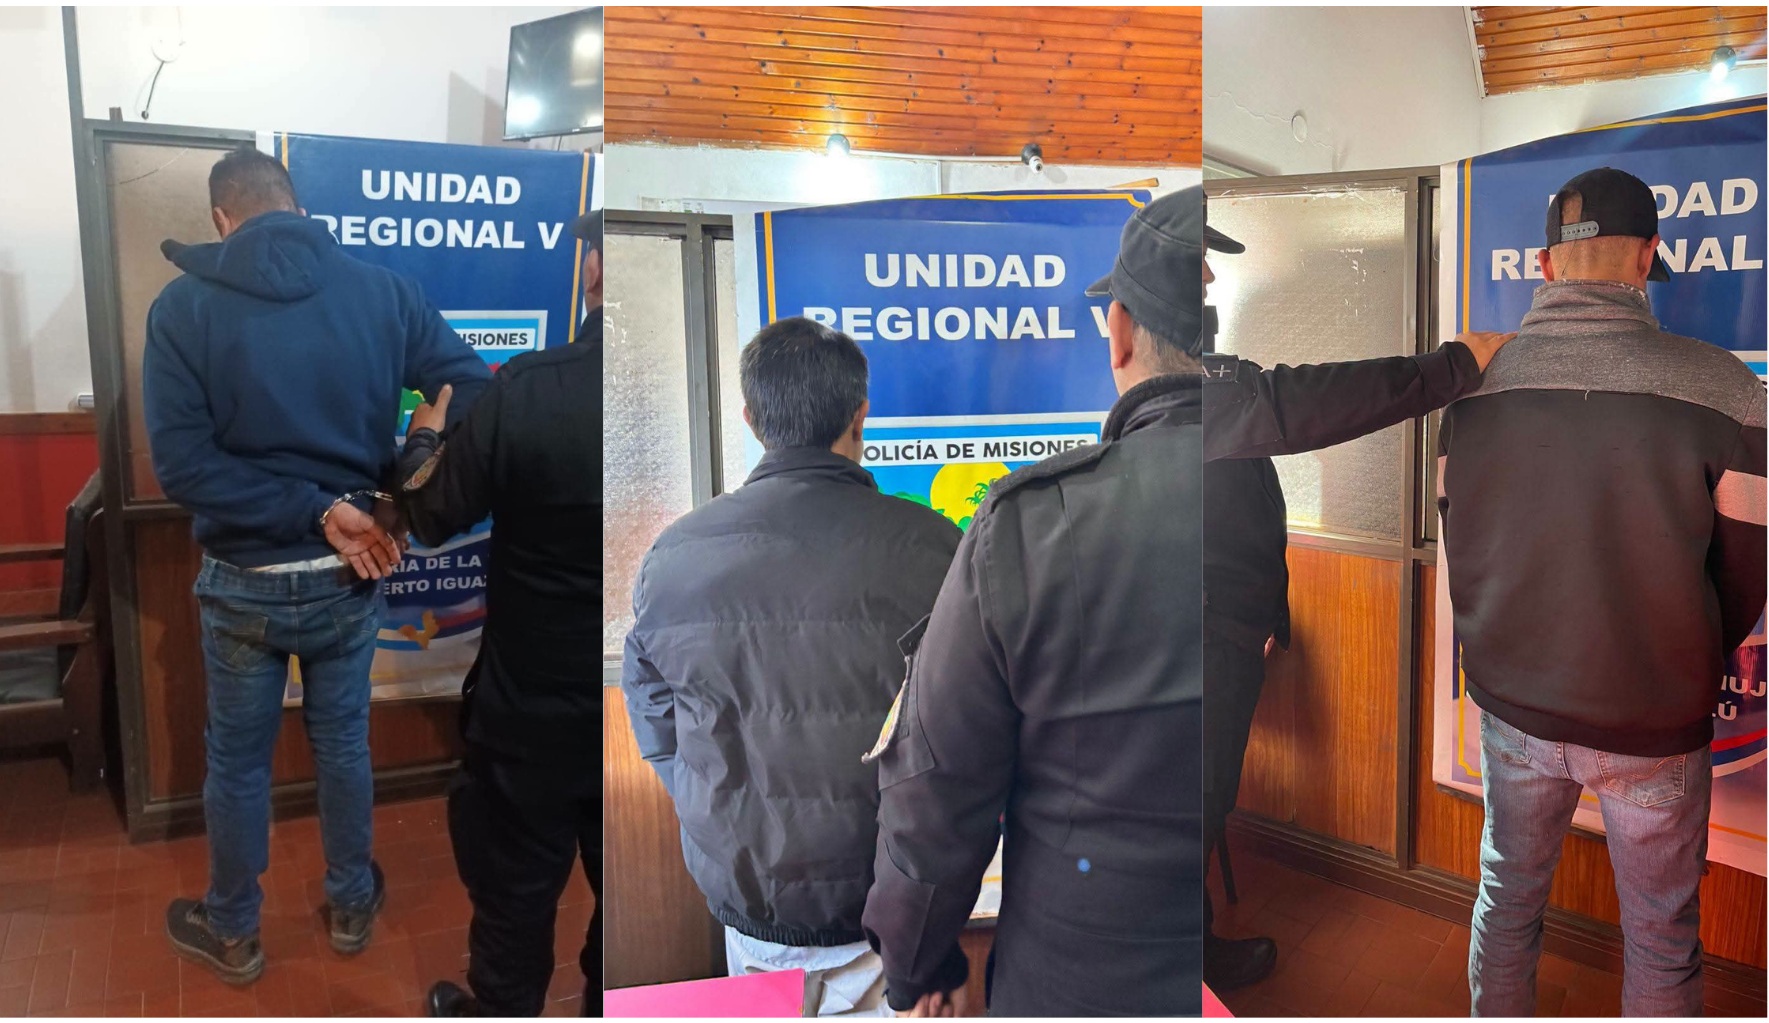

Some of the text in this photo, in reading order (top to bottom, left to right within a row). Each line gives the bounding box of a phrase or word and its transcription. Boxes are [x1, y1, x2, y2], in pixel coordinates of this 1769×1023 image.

[361, 169, 521, 205] UNIDAD
[538, 222, 564, 250] V
[864, 253, 1067, 289] UNIDAD
[803, 306, 1076, 341] REGIONAL
[462, 333, 528, 346] ISIONES
[863, 440, 938, 461] OLICÍA
[946, 443, 975, 459] DE
[425, 556, 451, 570] DE
[457, 555, 482, 568] LA
